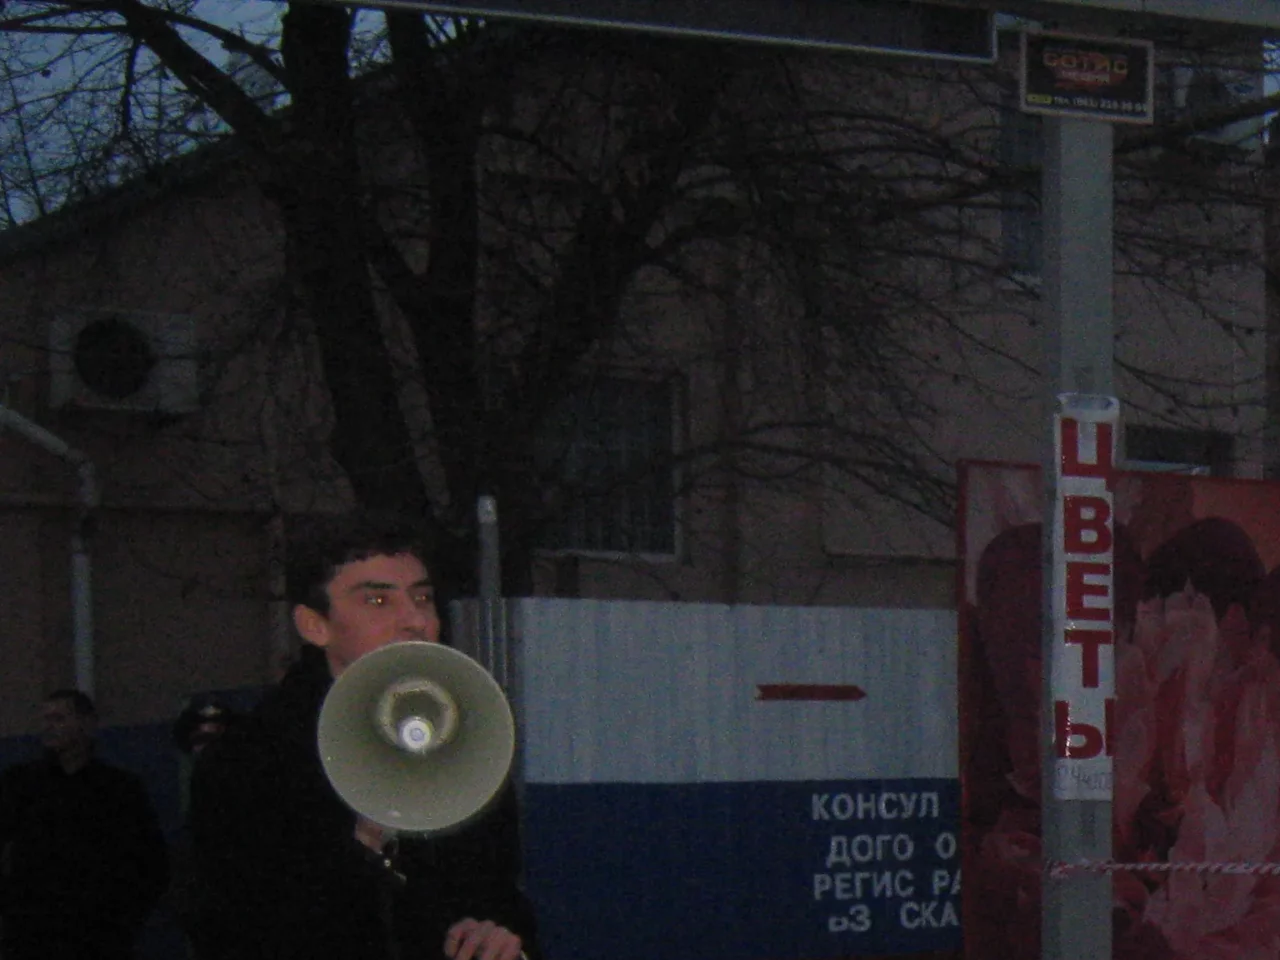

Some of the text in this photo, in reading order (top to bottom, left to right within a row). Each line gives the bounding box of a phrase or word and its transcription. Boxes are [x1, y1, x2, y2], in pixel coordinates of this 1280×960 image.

[1055, 417, 1115, 759] ЦВЕТЫ
[811, 791, 939, 820] КОНСУЛ
[825, 833, 914, 868] ДОГО
[813, 869, 914, 900] РЕГИС
[900, 901, 959, 929] СКА
